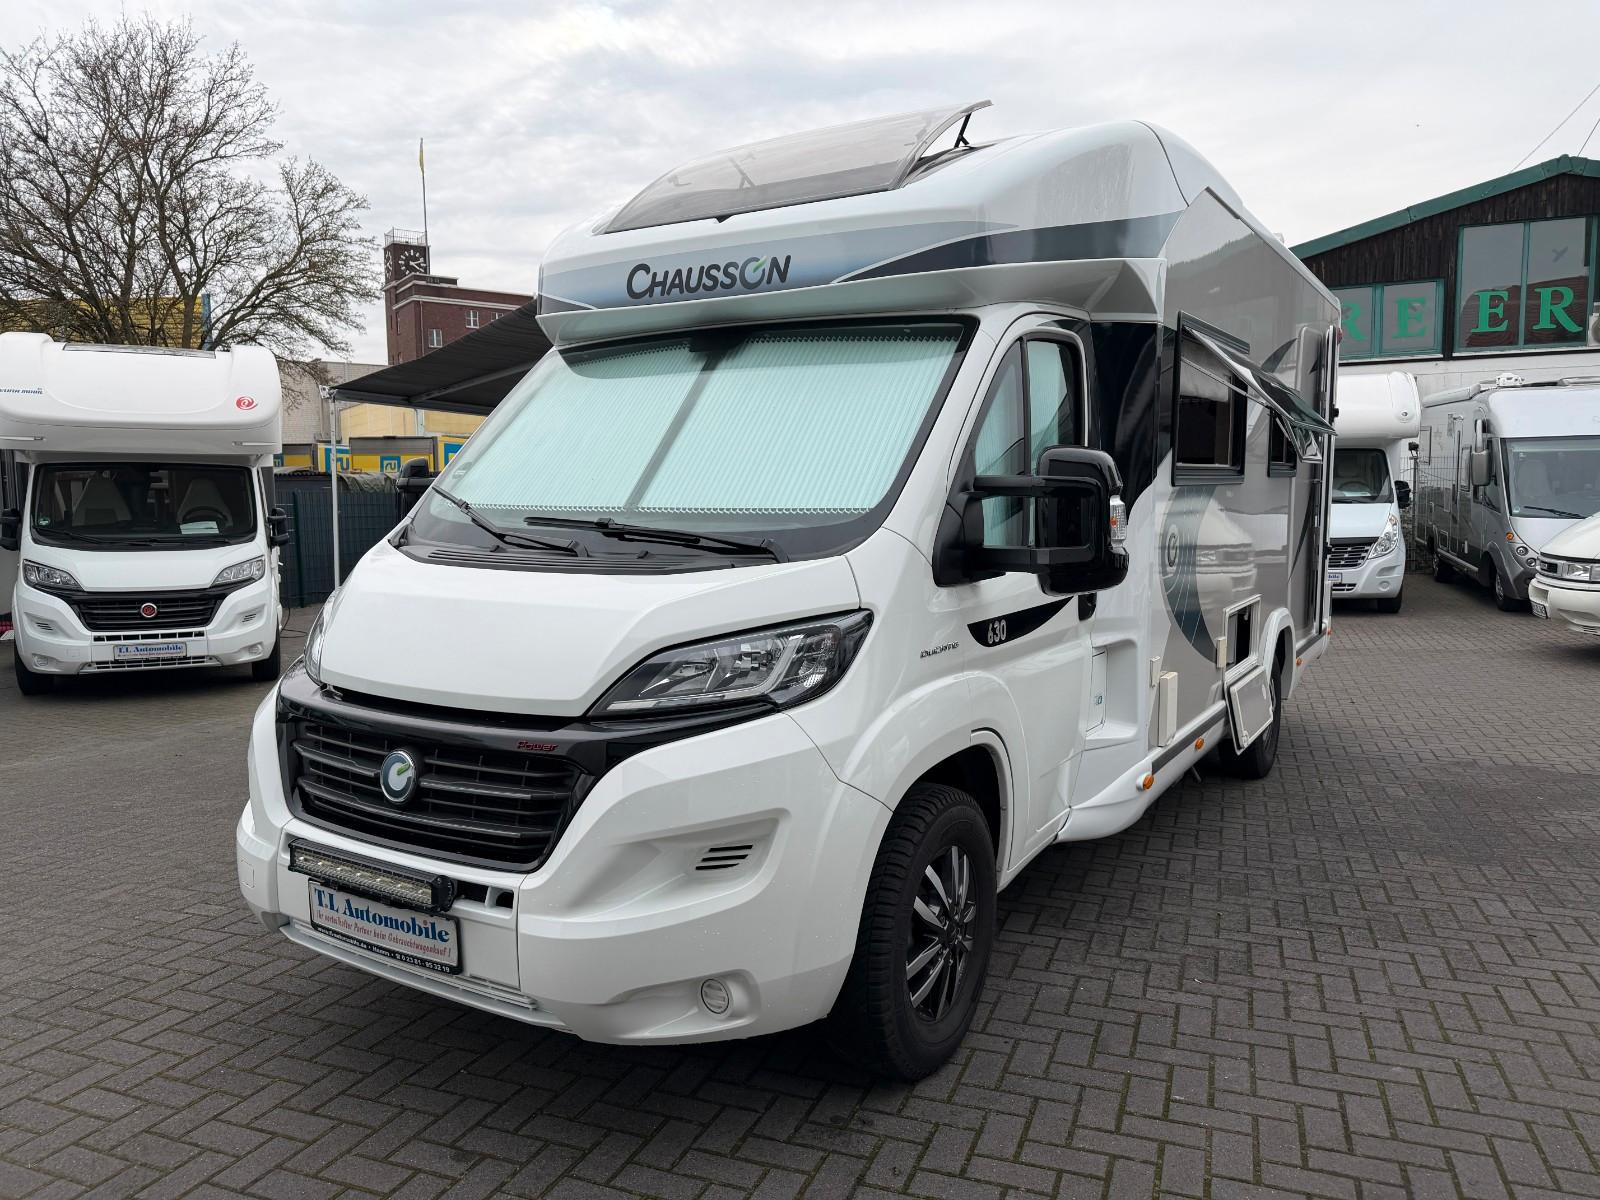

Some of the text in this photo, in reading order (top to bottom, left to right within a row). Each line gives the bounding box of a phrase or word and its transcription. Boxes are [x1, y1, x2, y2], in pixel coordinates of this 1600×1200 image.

[626, 254, 792, 300] CHAUSSON
[987, 619, 1007, 644] 630
[343, 898, 451, 943] Automobile
